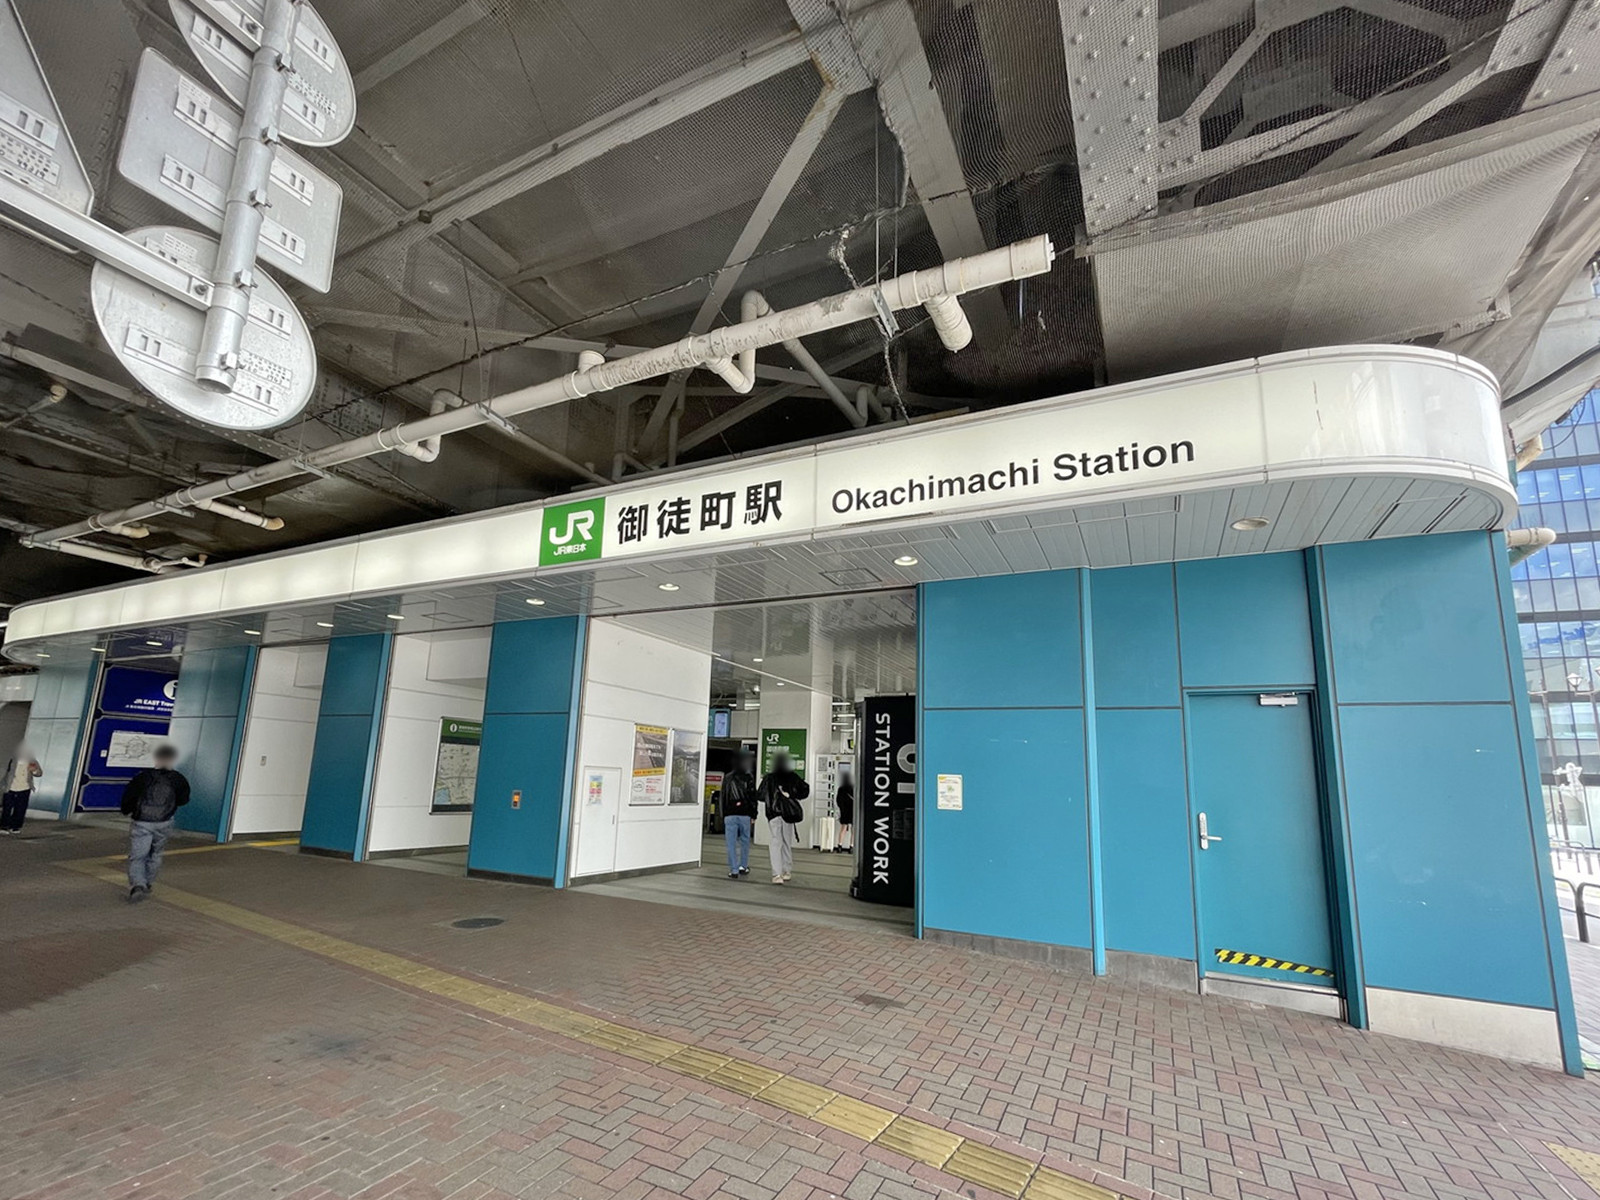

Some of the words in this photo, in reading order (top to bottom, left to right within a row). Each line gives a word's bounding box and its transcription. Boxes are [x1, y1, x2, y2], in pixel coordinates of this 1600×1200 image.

[831, 458, 1040, 514] Okachimachi
[1053, 440, 1195, 481] Station
[549, 509, 595, 545] JR
[617, 480, 783, 544] 御徒町駅
[553, 542, 587, 556] JR東日本
[766, 733, 780, 742] JR
[874, 713, 891, 807] STATION
[873, 816, 890, 885] WORK
